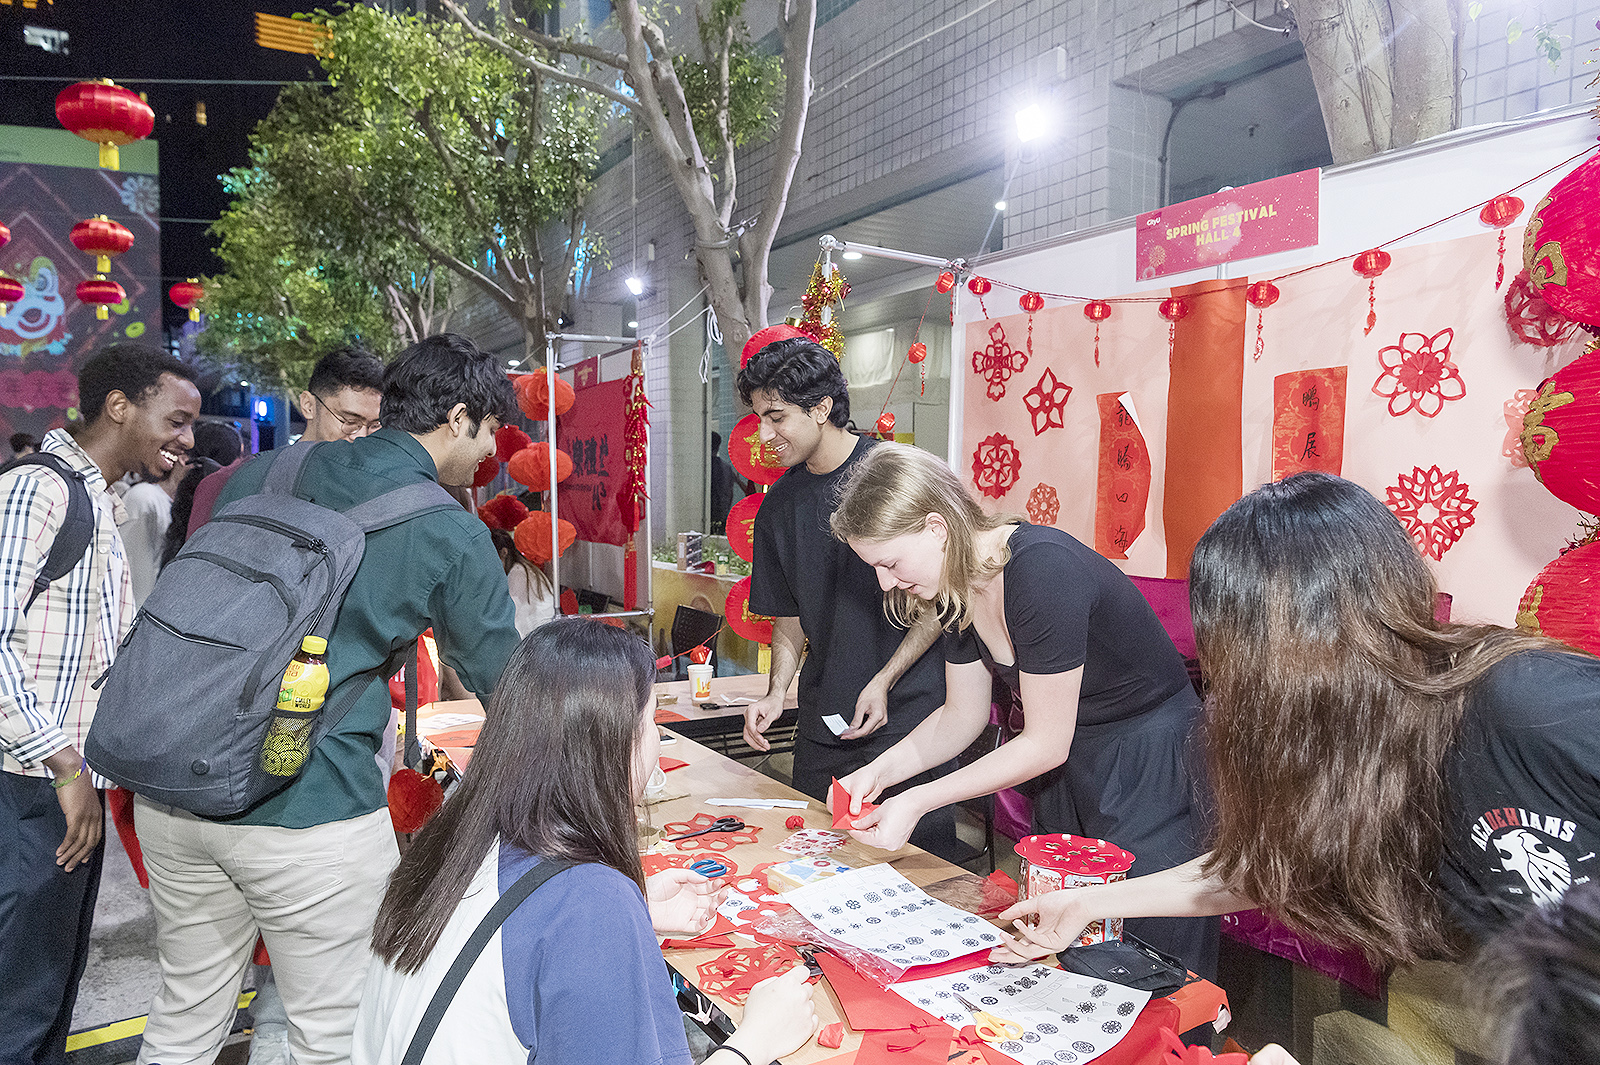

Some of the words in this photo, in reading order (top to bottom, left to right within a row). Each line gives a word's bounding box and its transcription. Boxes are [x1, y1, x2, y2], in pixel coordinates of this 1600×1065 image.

[1166, 221, 1209, 240] SPRING
[1212, 204, 1277, 229] FESTIVAL
[1196, 229, 1229, 246] HALL
[1232, 226, 1241, 237] 4
